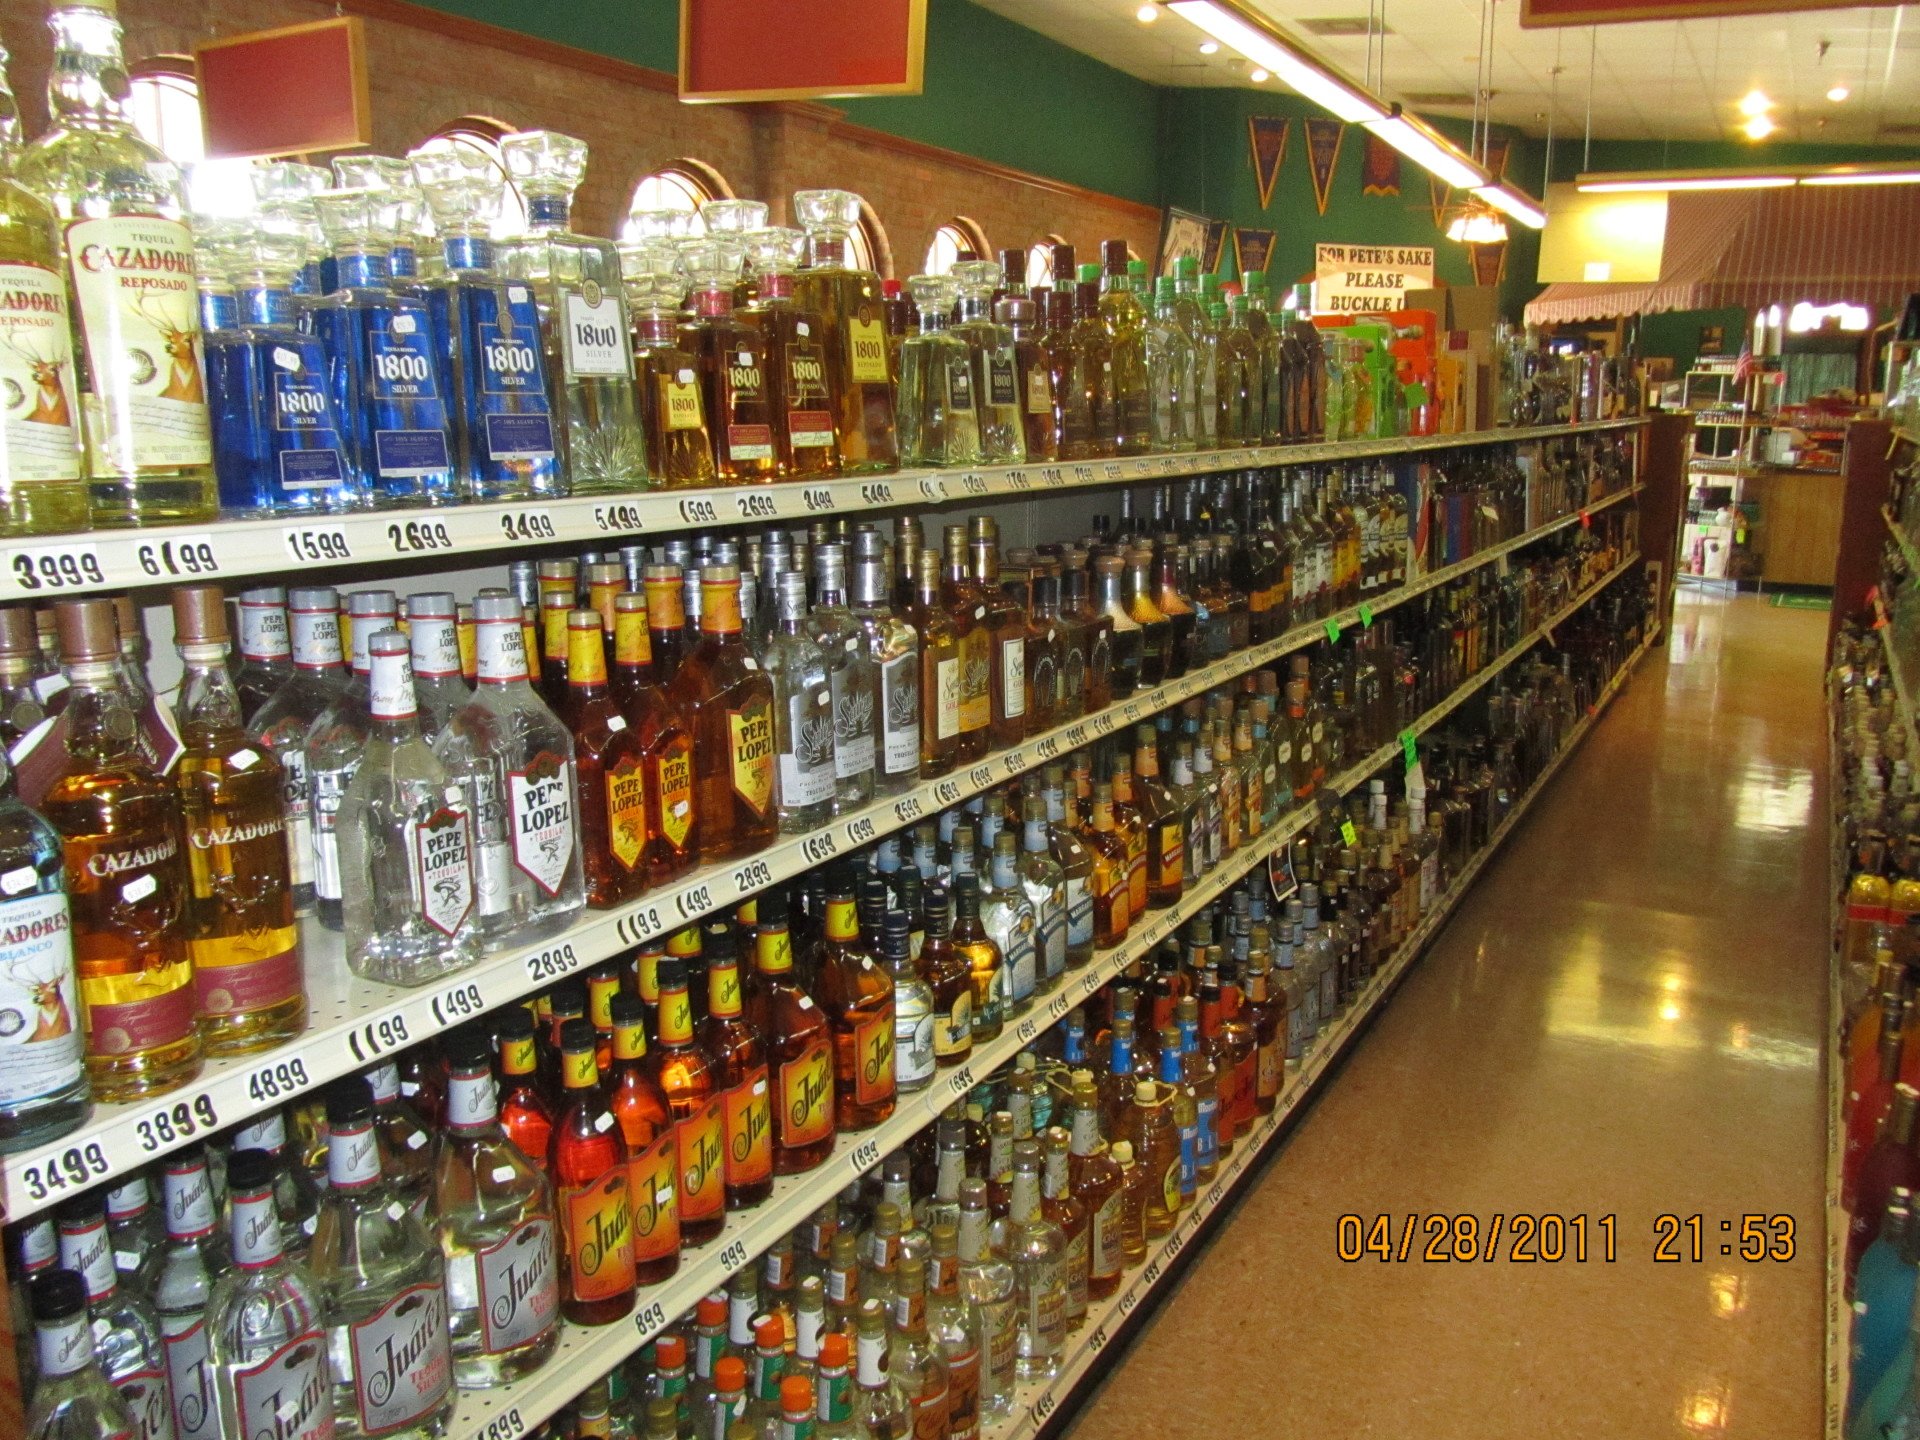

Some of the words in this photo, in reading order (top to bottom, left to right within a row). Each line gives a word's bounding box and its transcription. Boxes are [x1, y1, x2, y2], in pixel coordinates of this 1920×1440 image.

[131, 232, 175, 246] TEQUILA
[79, 243, 197, 275] CAZADORE
[1318, 247, 1345, 264] FOR
[1350, 248, 1394, 265] PETE'S
[1397, 249, 1432, 265] SAKE
[120, 276, 188, 292] REPOSADO
[1345, 272, 1404, 289] PLEASE
[0, 290, 65, 315] ADORE
[1330, 296, 1393, 312] BUCKLE
[1395, 297, 1407, 312] U
[575, 323, 617, 348] 1800
[484, 346, 535, 373] 1800
[854, 340, 880, 359] 1800
[375, 354, 428, 381] 1800
[728, 367, 760, 388] 1800
[791, 361, 821, 381] 1800
[391, 384, 419, 394] SILVER
[500, 376, 526, 386] SILVER
[278, 391, 327, 414] 1800
[671, 398, 696, 412] 1800
[292, 415, 318, 425] SILVER
[803, 489, 835, 510] 3499
[861, 483, 895, 503] 5499
[594, 506, 643, 531] 5499
[679, 499, 718, 523] 1599
[737, 495, 778, 518] 2699
[388, 522, 453, 552] 2699
[501, 513, 556, 541] 3499
[138, 541, 219, 576] 6199
[288, 531, 352, 561] 1599
[11, 552, 105, 590] 3999
[441, 628, 455, 638] PEP
[501, 641, 524, 652] LOPE
[739, 719, 768, 744] PEPE
[737, 736, 772, 763] LOPEZ
[662, 762, 687, 781] PEPE
[523, 781, 563, 811] PEPE
[613, 778, 640, 798] PEPE
[661, 775, 690, 795] LOPEZ
[611, 791, 643, 815] LOPEZ
[894, 798, 922, 821] 3599
[521, 801, 569, 834] LOPEZ
[190, 820, 285, 849] CAZADORE
[426, 831, 462, 854] PEPE
[848, 818, 876, 845] 1999
[87, 836, 177, 877] CAZADOR
[424, 846, 467, 872] LOPEZ
[802, 832, 837, 862] 1699
[735, 861, 772, 893] 2899
[676, 886, 714, 919] 1499
[0, 908, 69, 946] ADORES
[3, 909, 42, 924] TEQUILA
[616, 907, 662, 945] 1199
[527, 943, 579, 982] 2899
[431, 983, 485, 1026] 1499
[348, 1014, 410, 1061] 1199
[248, 1057, 310, 1102] 4899
[949, 1066, 974, 1093] 1699
[136, 1093, 218, 1153] 3899
[851, 1140, 880, 1172] 1899
[23, 1142, 109, 1200] 3499
[720, 1240, 748, 1271] 999
[634, 1303, 665, 1336] 899
